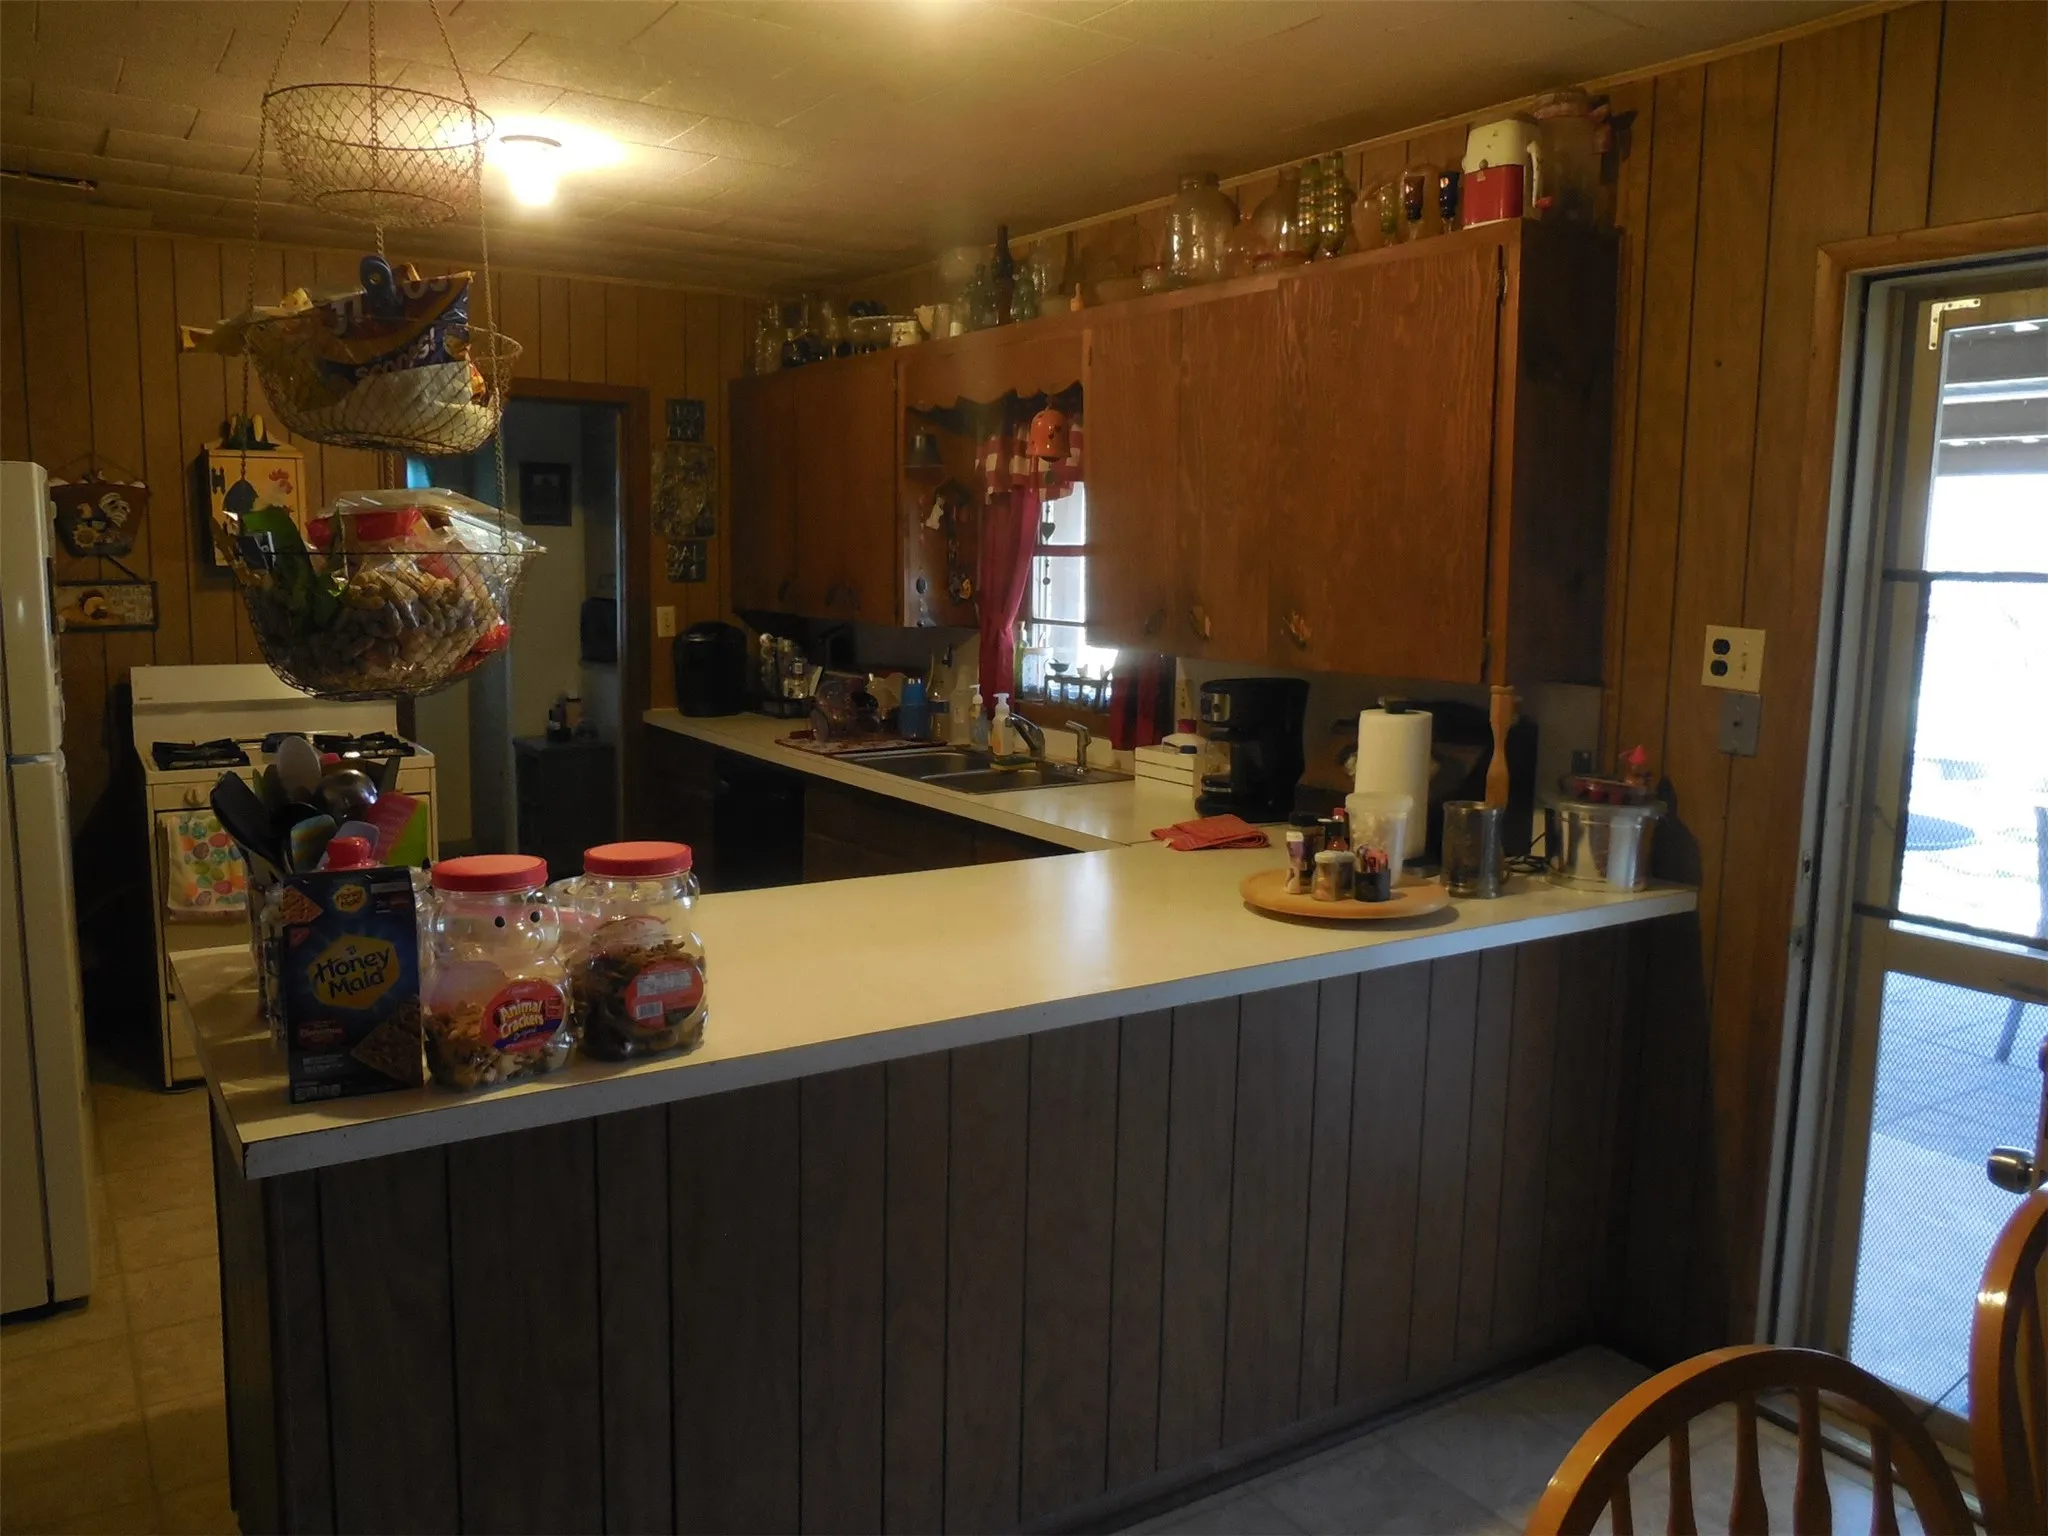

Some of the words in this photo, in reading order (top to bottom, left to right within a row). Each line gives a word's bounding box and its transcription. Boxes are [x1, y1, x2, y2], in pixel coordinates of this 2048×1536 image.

[315, 947, 390, 983] Honey
[328, 967, 385, 999] Maid
[499, 999, 544, 1022] Animal
[500, 1013, 545, 1038] Crackers
